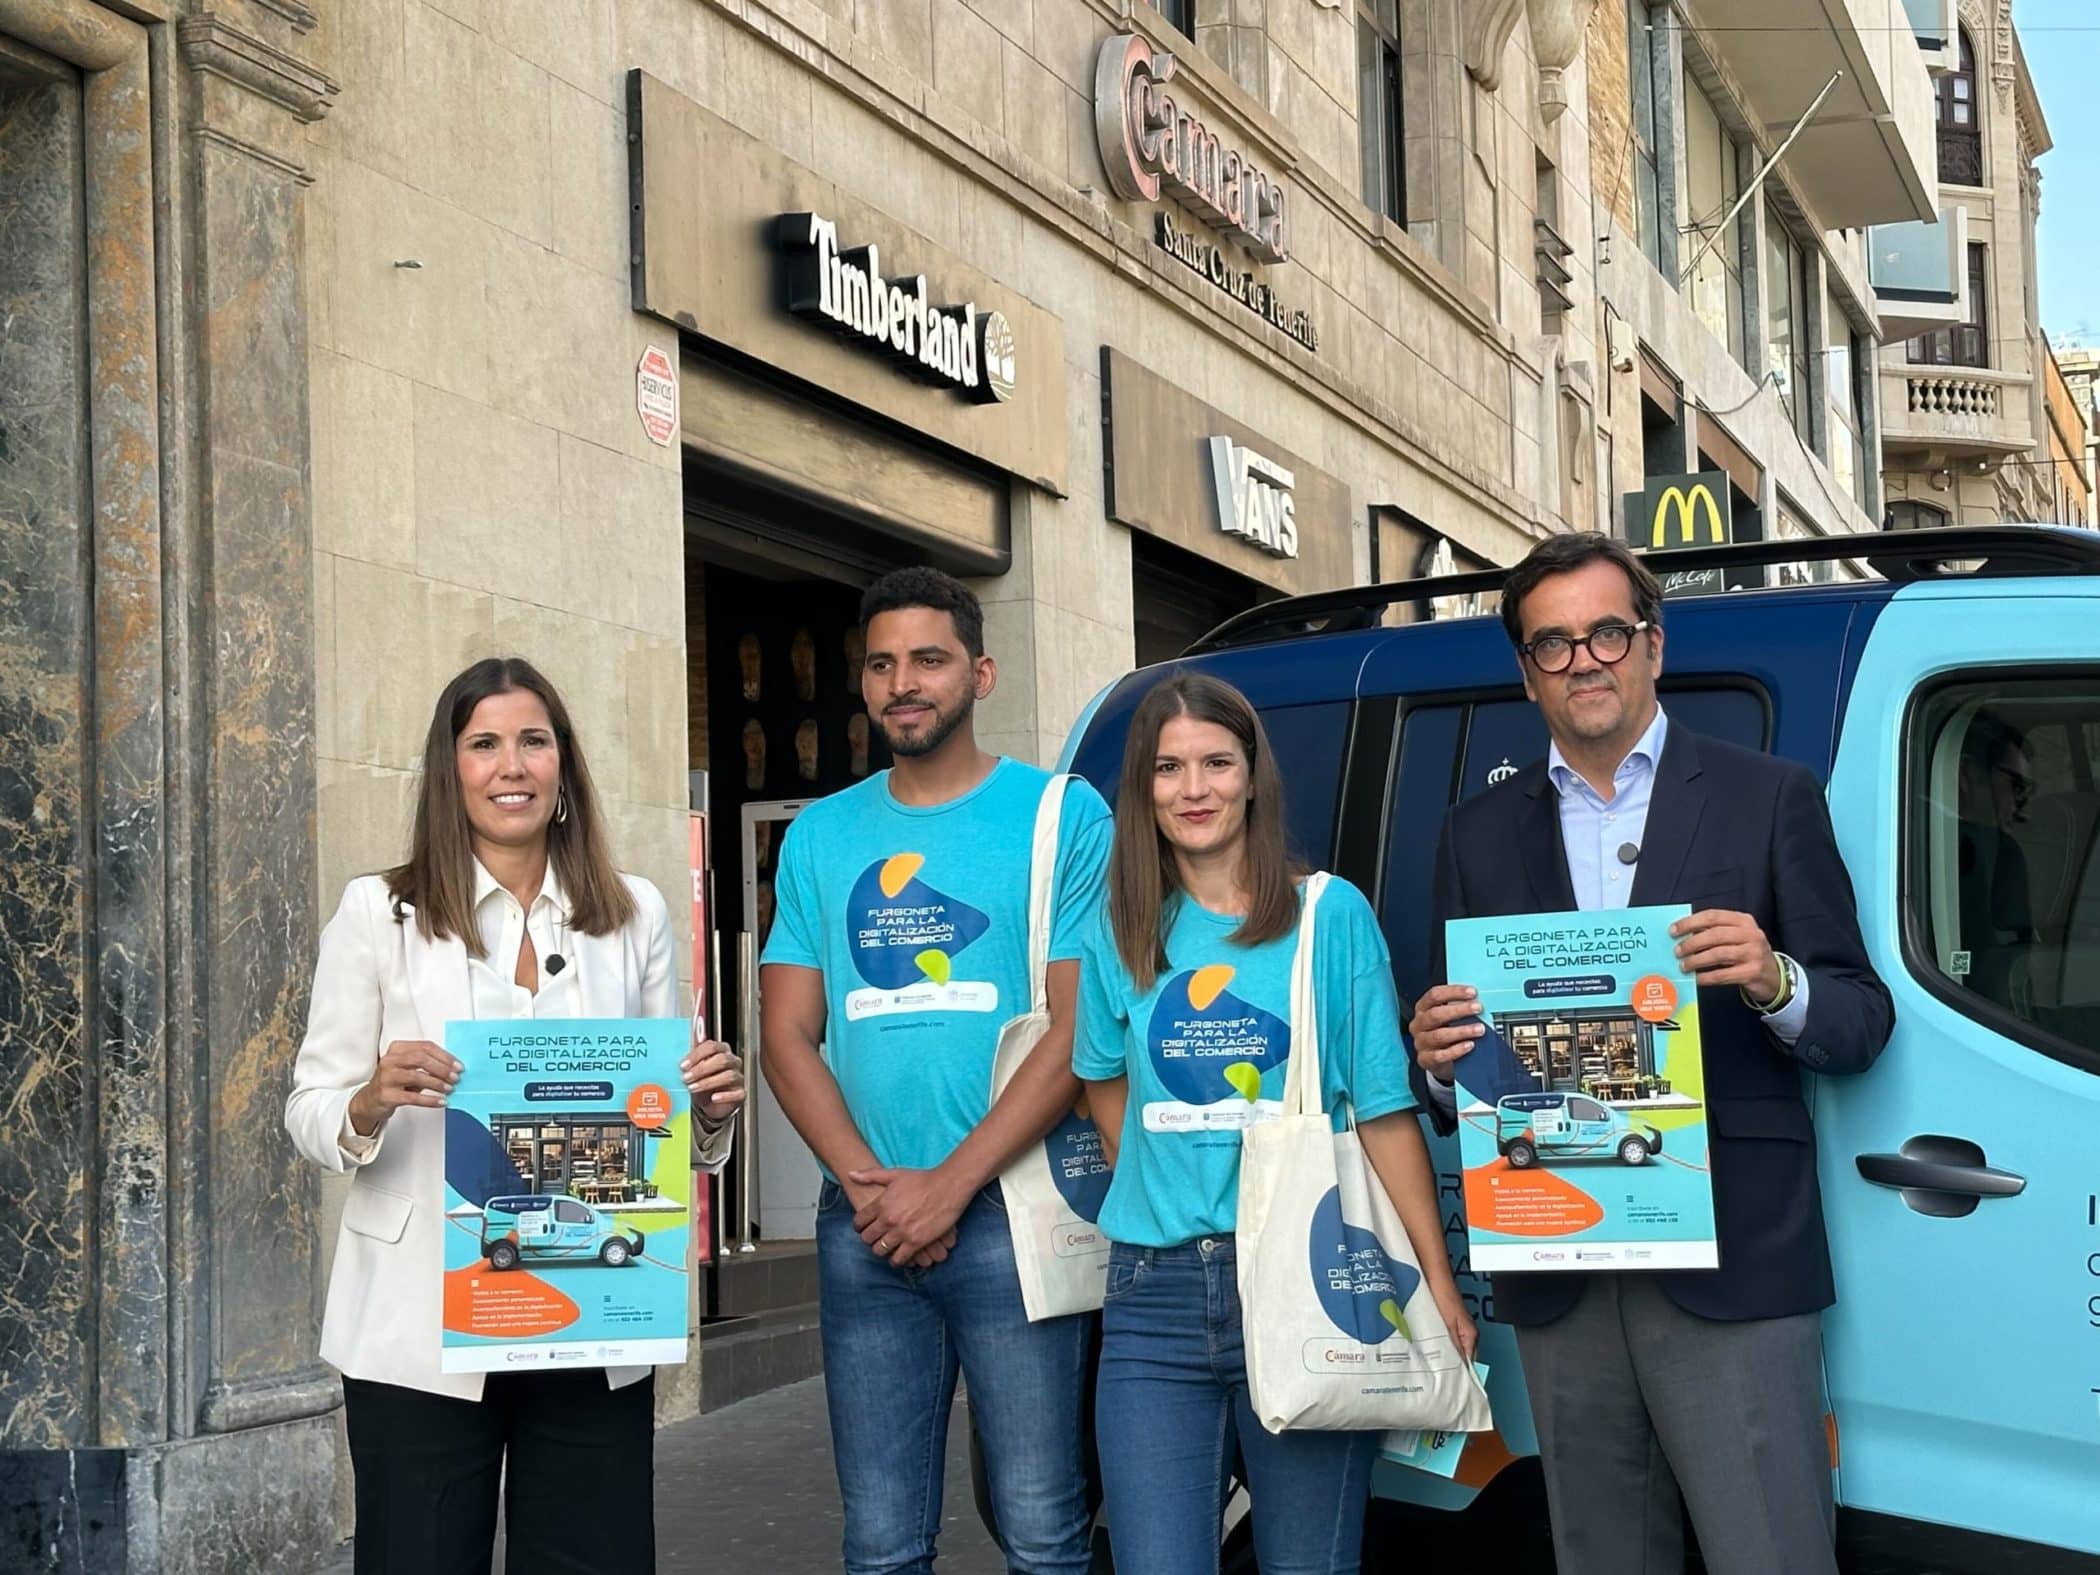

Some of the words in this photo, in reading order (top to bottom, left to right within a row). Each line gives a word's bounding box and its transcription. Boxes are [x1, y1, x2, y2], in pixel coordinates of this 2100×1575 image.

[1164, 211, 1207, 275] Santa
[1210, 245, 1248, 303] Cruz
[808, 212, 979, 387] Timberland
[1209, 435, 1297, 558] VANS
[867, 905, 946, 918] FURGONETA
[876, 917, 915, 926] PARA
[918, 916, 937, 925] LA
[858, 924, 955, 938] DIGITALIZACIÓN
[1485, 929, 1589, 944] FURGONETA
[1593, 926, 1646, 937] PARA
[860, 938, 885, 948] DEL
[888, 934, 953, 946] COMERCIO
[1486, 947, 1511, 958] LA
[1515, 936, 1648, 957] DIGITALIZACIÓN
[1503, 958, 1537, 970] DEL
[1542, 953, 1632, 968] COMERCIO
[1174, 1018, 1258, 1029] FURGONETA
[1183, 1029, 1225, 1038] PARA
[1228, 1028, 1248, 1037] LA
[488, 1036, 592, 1047] FURGONETA
[597, 1036, 648, 1046] PARA
[1161, 1035, 1268, 1048] DIGITALIZACIÓN
[489, 1049, 513, 1059] LA
[518, 1046, 648, 1059] DIGITALIZACIÓN
[1163, 1048, 1190, 1058] DEL
[1195, 1047, 1266, 1057] COMERCIO
[506, 1062, 539, 1072] DEL
[545, 1061, 632, 1072] COMERCIO
[1064, 1168, 1088, 1178] DEL
